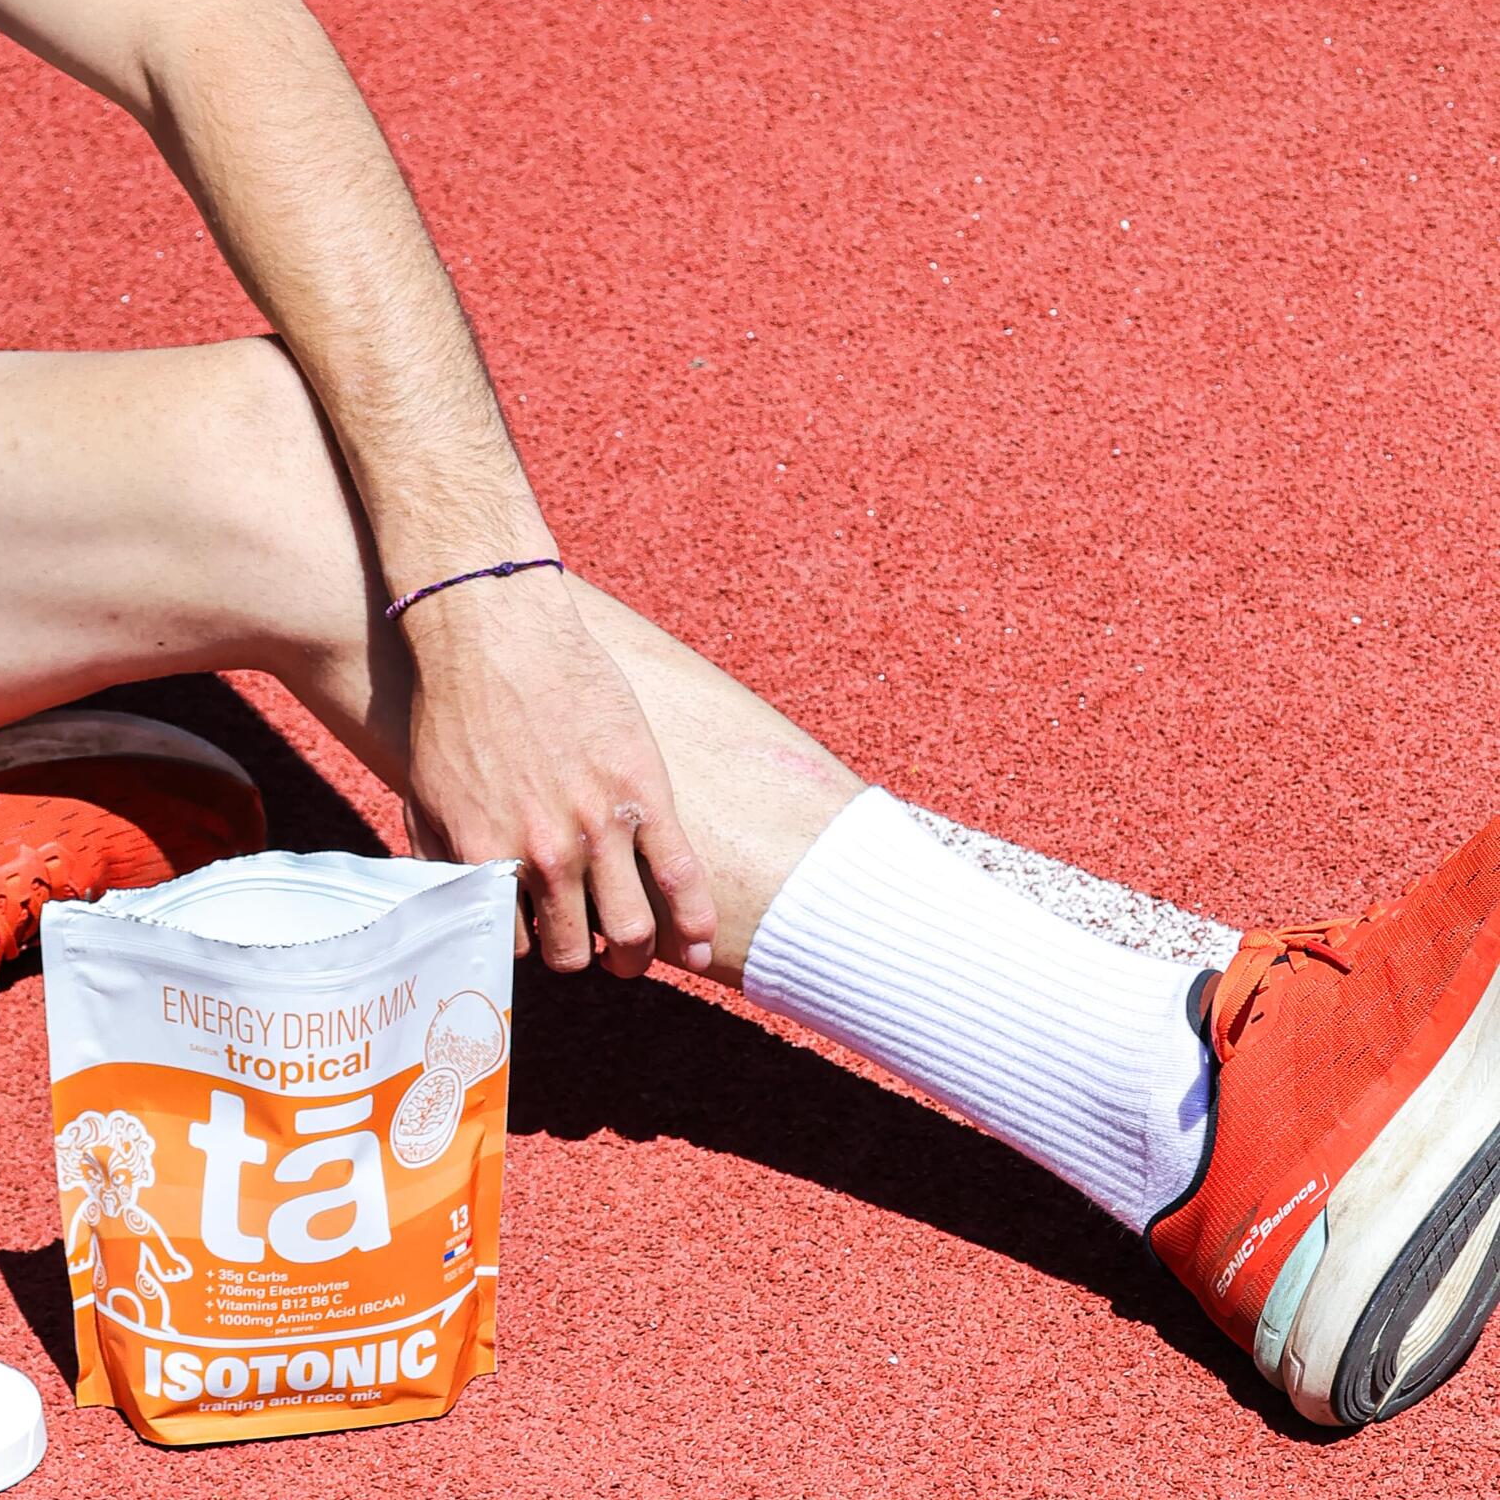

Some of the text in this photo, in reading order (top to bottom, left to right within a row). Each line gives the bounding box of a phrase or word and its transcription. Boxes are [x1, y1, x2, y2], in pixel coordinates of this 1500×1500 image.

[163, 974, 418, 1050] ENERGY DRINK MIX
[224, 1040, 371, 1090] tropical
[449, 1204, 469, 1233] 13
[218, 1269, 244, 1284] 35g
[247, 1270, 288, 1283] Carbs
[218, 1284, 265, 1299] 706mg
[269, 1280, 350, 1297] Electrolytes
[216, 1298, 278, 1311] Vitamins
[281, 1298, 308, 1311] B12
[311, 1295, 329, 1307] B6
[332, 1293, 343, 1305] C
[218, 1314, 274, 1327] 1000mg
[276, 1310, 323, 1325] Amino
[324, 1305, 356, 1320] Acid
[359, 1293, 406, 1316] (BCAA)
[143, 1328, 438, 1402] ISOTONIC
[199, 1388, 383, 1413] training and race mix
